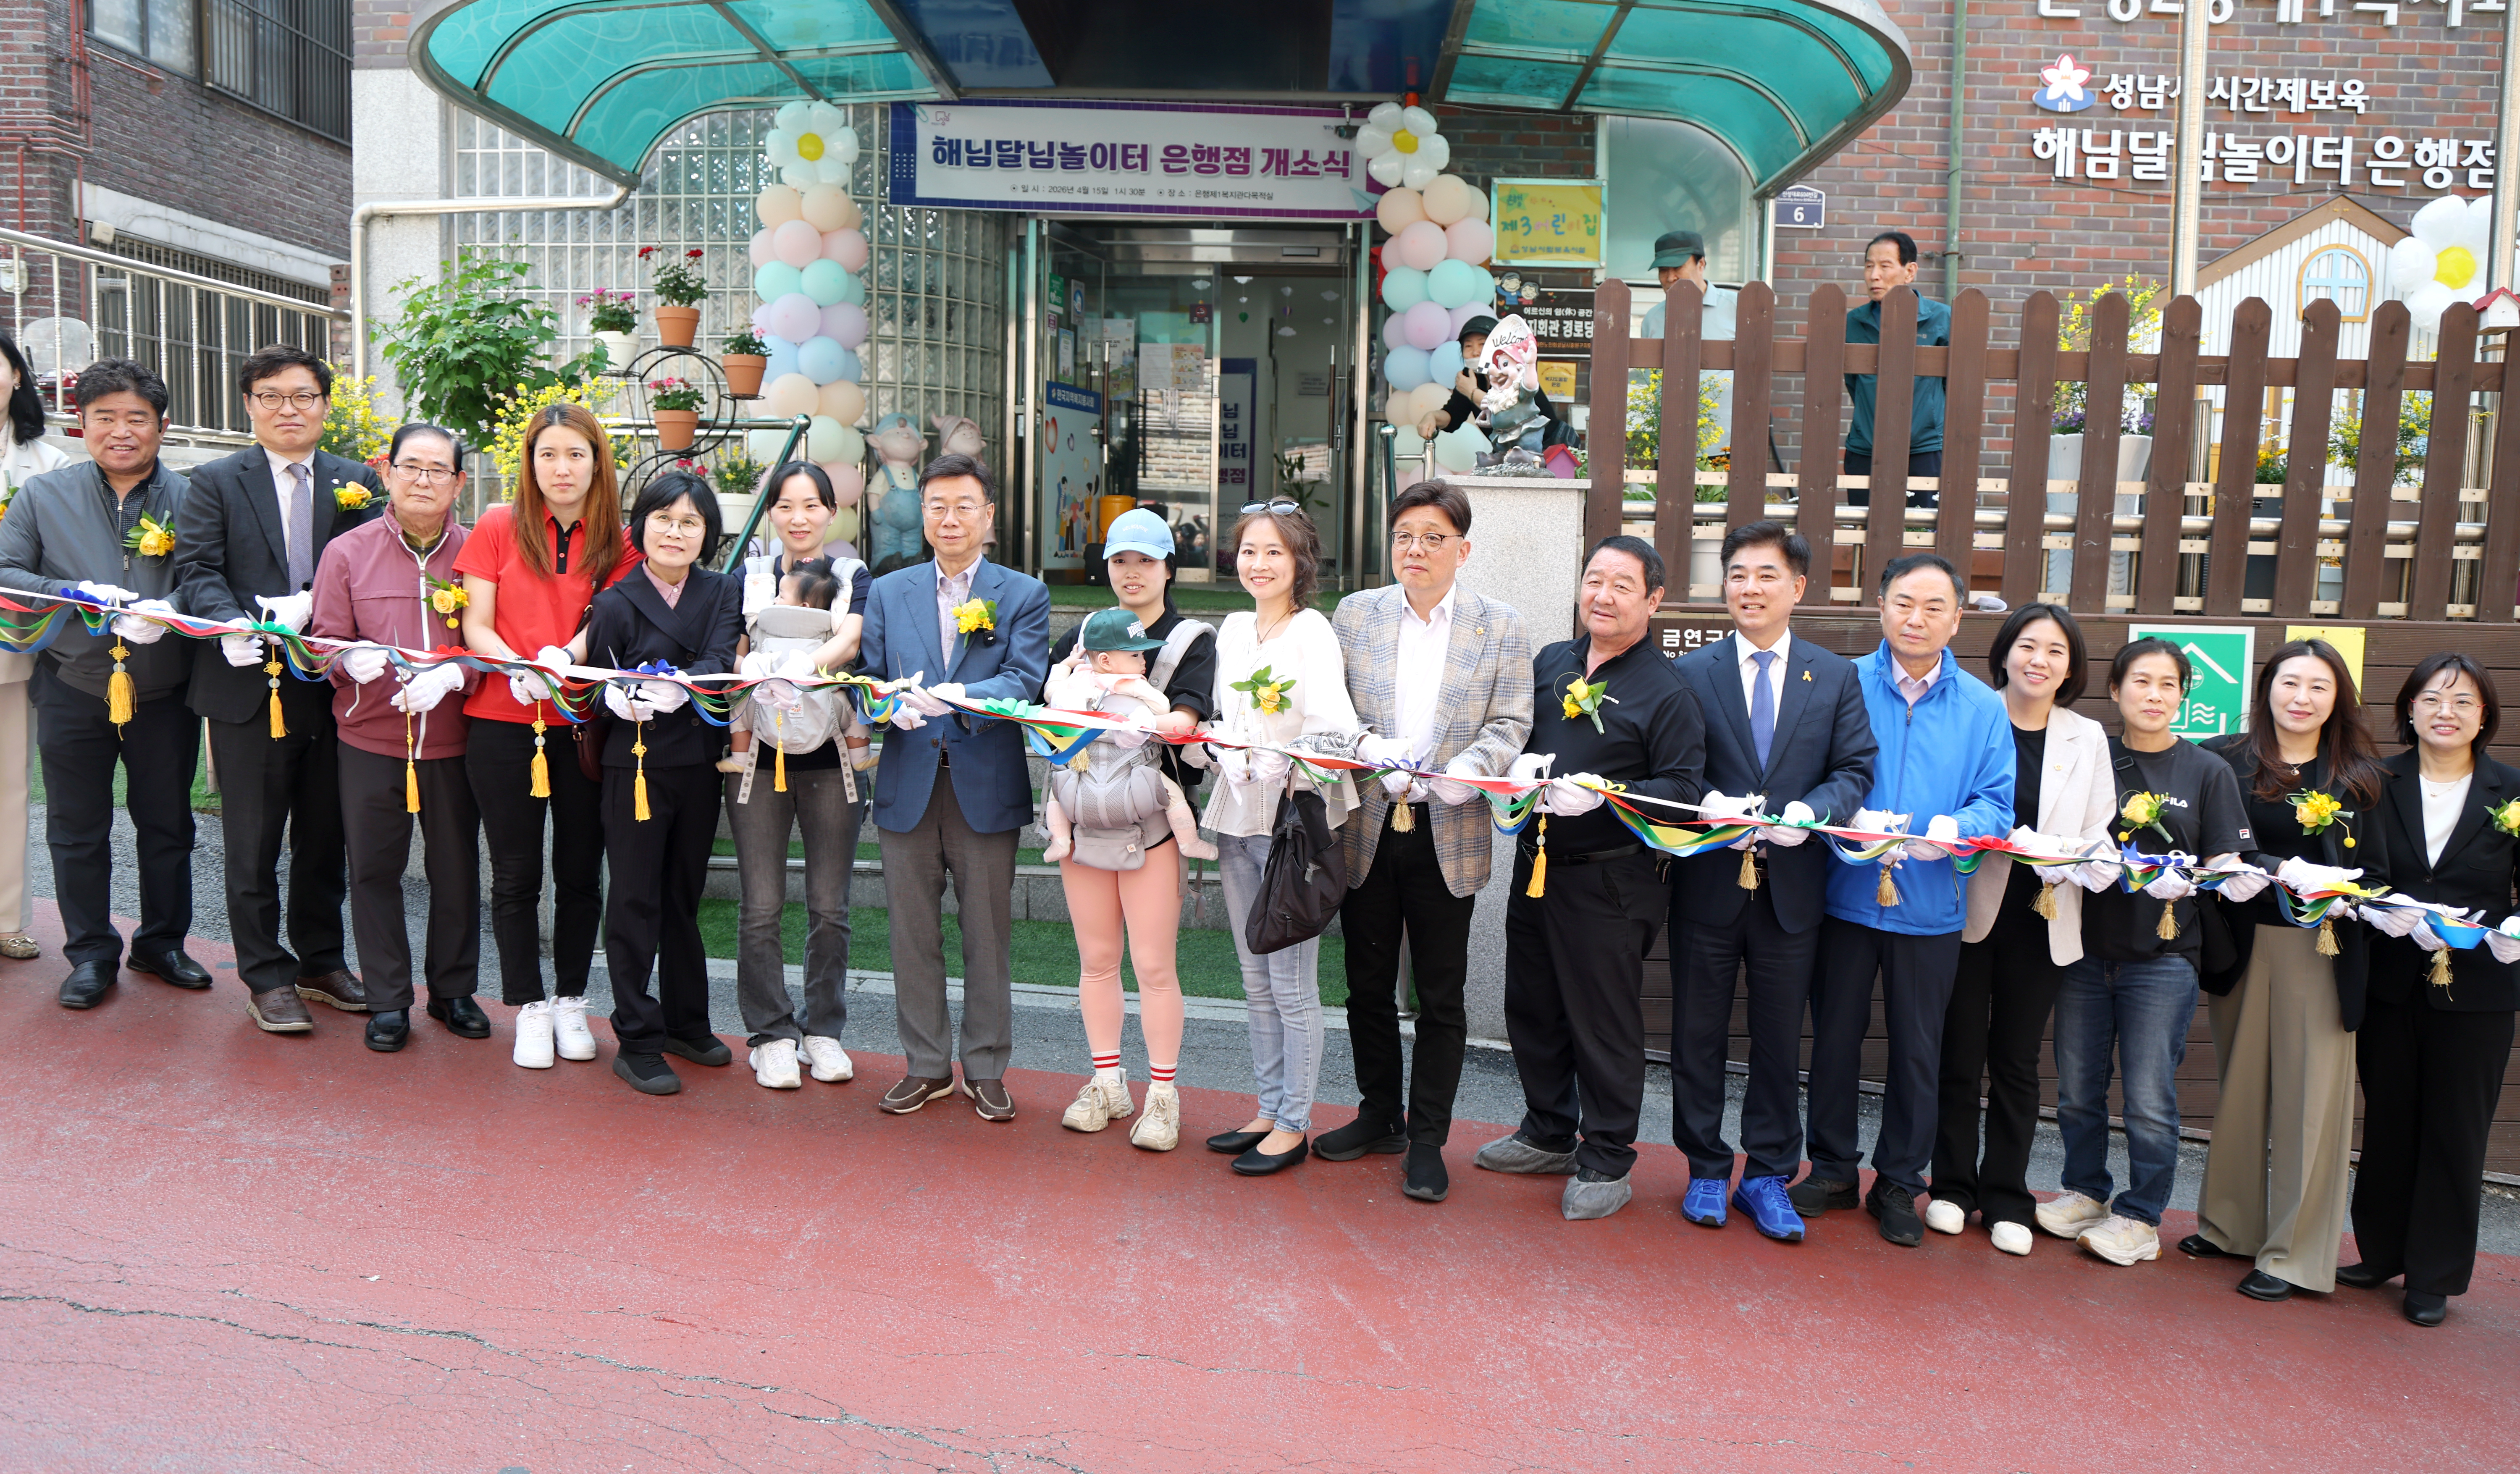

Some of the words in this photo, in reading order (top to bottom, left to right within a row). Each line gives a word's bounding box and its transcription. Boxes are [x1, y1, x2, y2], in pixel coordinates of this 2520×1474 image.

[2103, 73, 2181, 110] 성남
[2208, 76, 2370, 114] 시간제보육
[932, 135, 1148, 171] 해님달님놀이터
[1160, 143, 1251, 175] 은행점
[1260, 148, 1350, 178] 개소식
[1048, 185, 1074, 194] 2026년
[1793, 206, 1805, 223] 6
[1523, 307, 1552, 316] 어르신의
[1578, 309, 1593, 317] 공간
[1525, 318, 1560, 337] 지회관
[1220, 403, 1239, 418] 님
[1220, 423, 1239, 439] 님
[1122, 524, 1149, 533] MELBOURNE
[1662, 629, 1735, 648] 금연구
[2163, 796, 2188, 808] FILA
